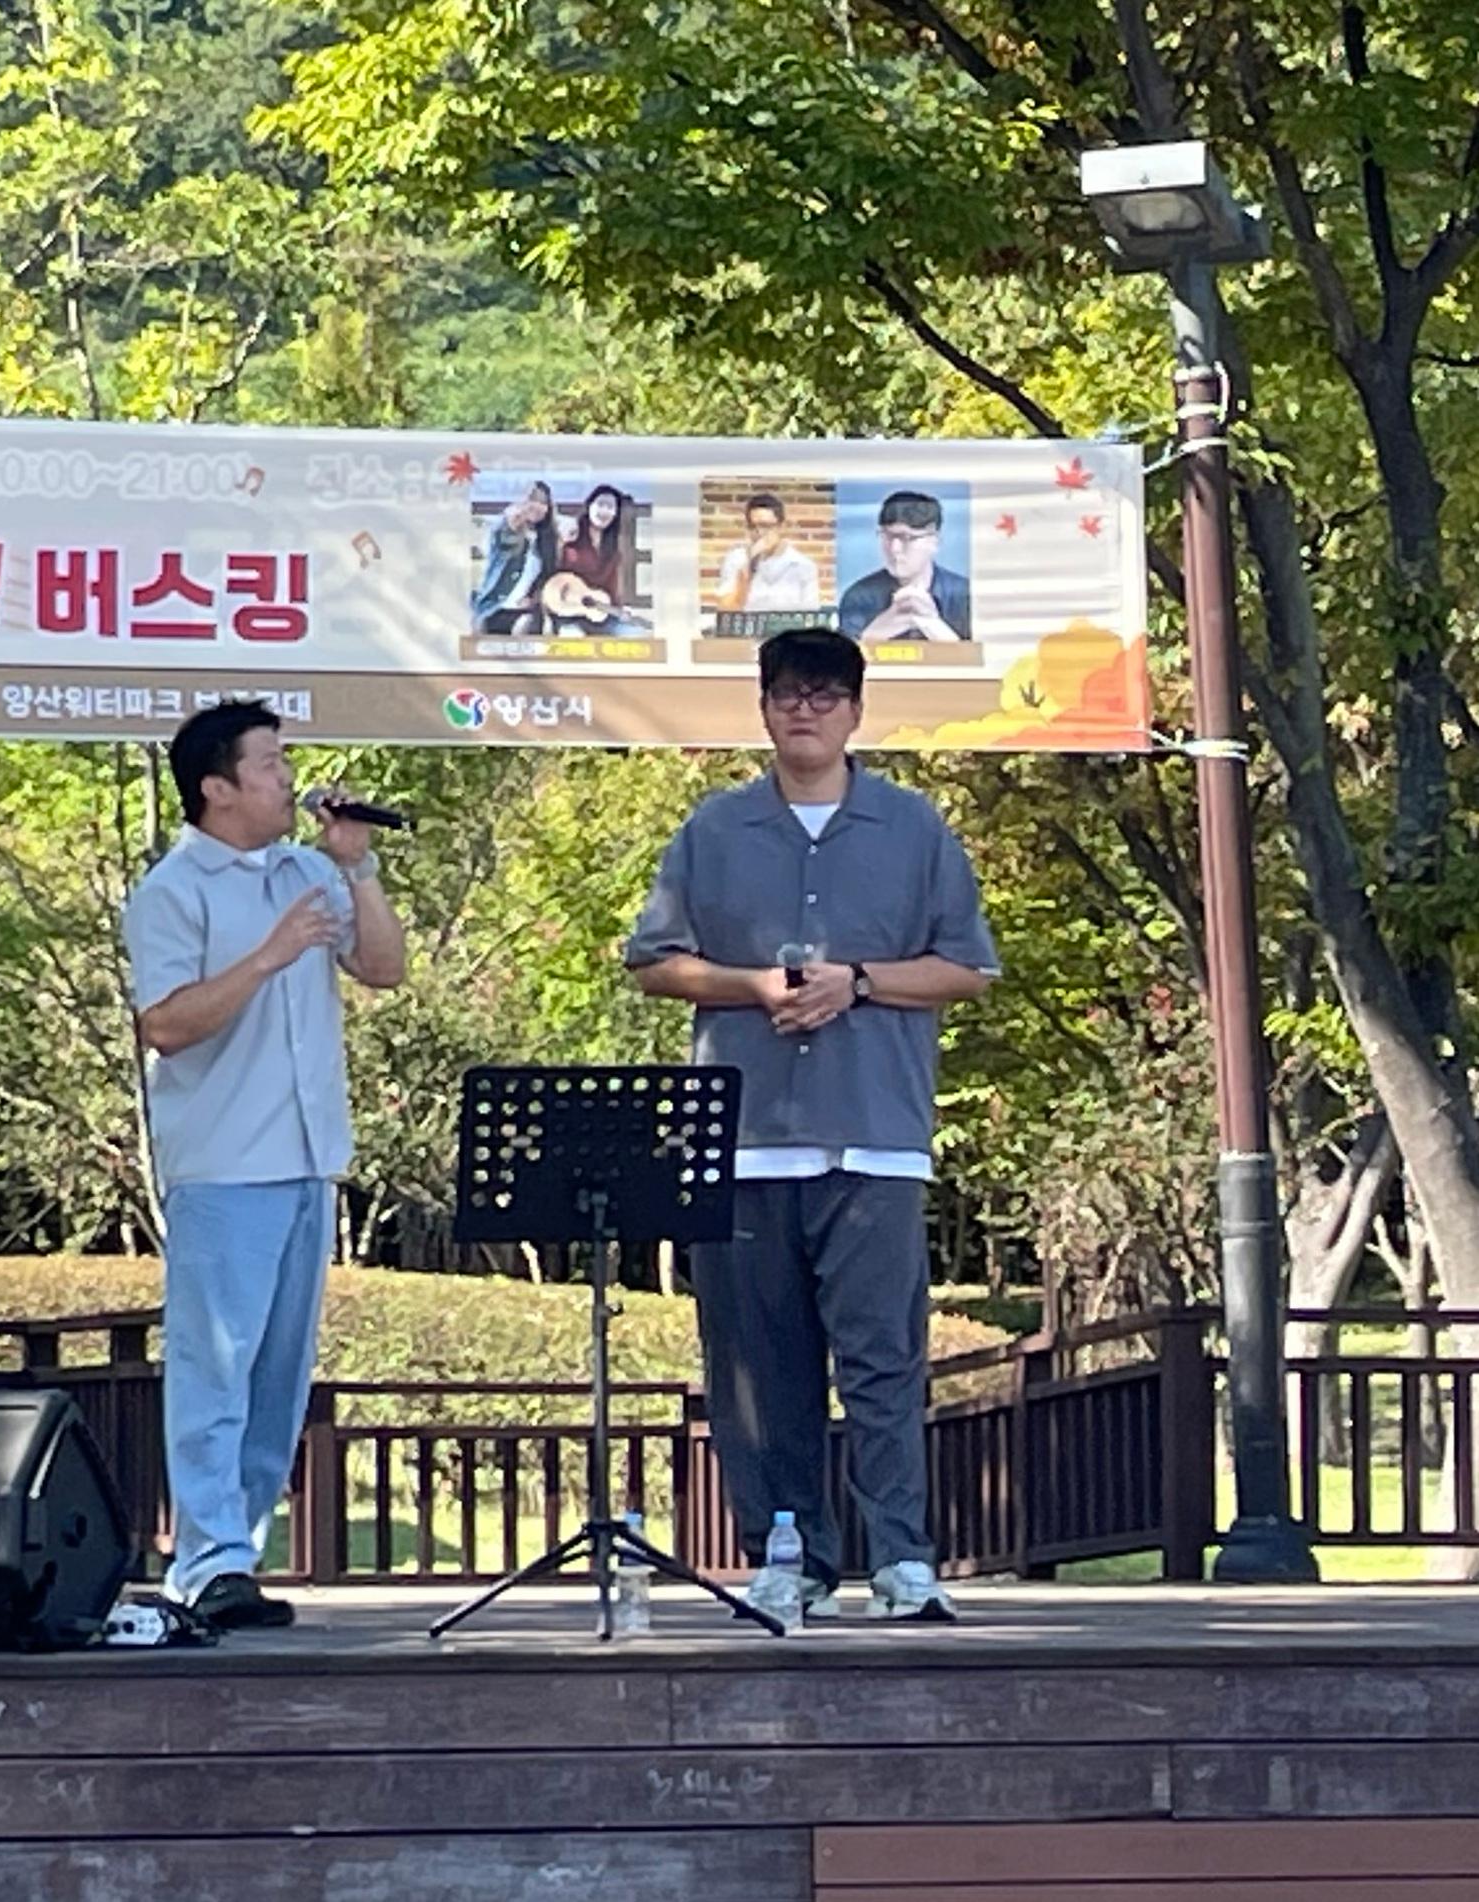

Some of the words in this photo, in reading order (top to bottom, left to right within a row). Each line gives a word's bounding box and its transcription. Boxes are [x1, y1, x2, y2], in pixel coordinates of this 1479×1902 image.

[35, 548, 310, 642] 버스킹
[1, 684, 186, 720] 양산워터파크
[492, 694, 593, 727] 양산시
